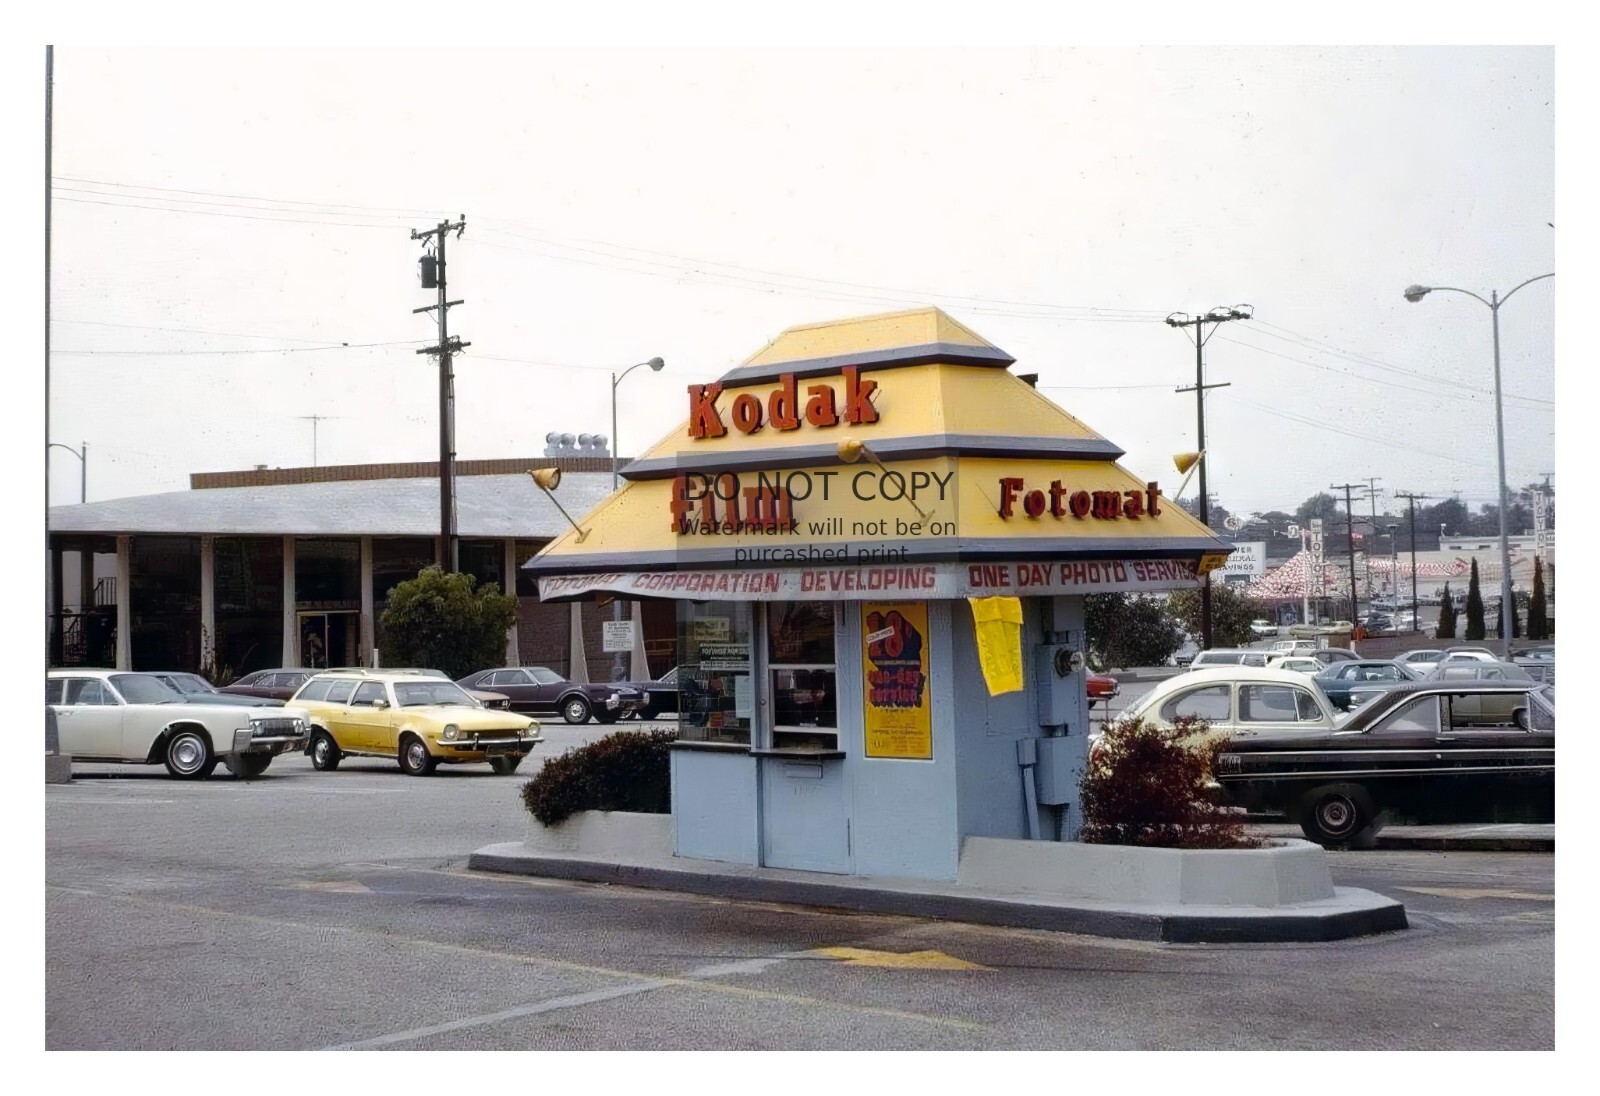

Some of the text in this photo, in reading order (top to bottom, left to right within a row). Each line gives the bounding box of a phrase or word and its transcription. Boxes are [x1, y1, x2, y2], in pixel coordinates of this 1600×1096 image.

[688, 366, 880, 440] Kodak
[670, 475, 797, 535] film
[998, 477, 1163, 520] Fotomat
[631, 571, 780, 593] CORPORATION
[801, 566, 937, 593] DEVELOPING
[968, 564, 1011, 588] ONE
[1016, 562, 1054, 588] DAY
[1060, 561, 1128, 586] PHOTO
